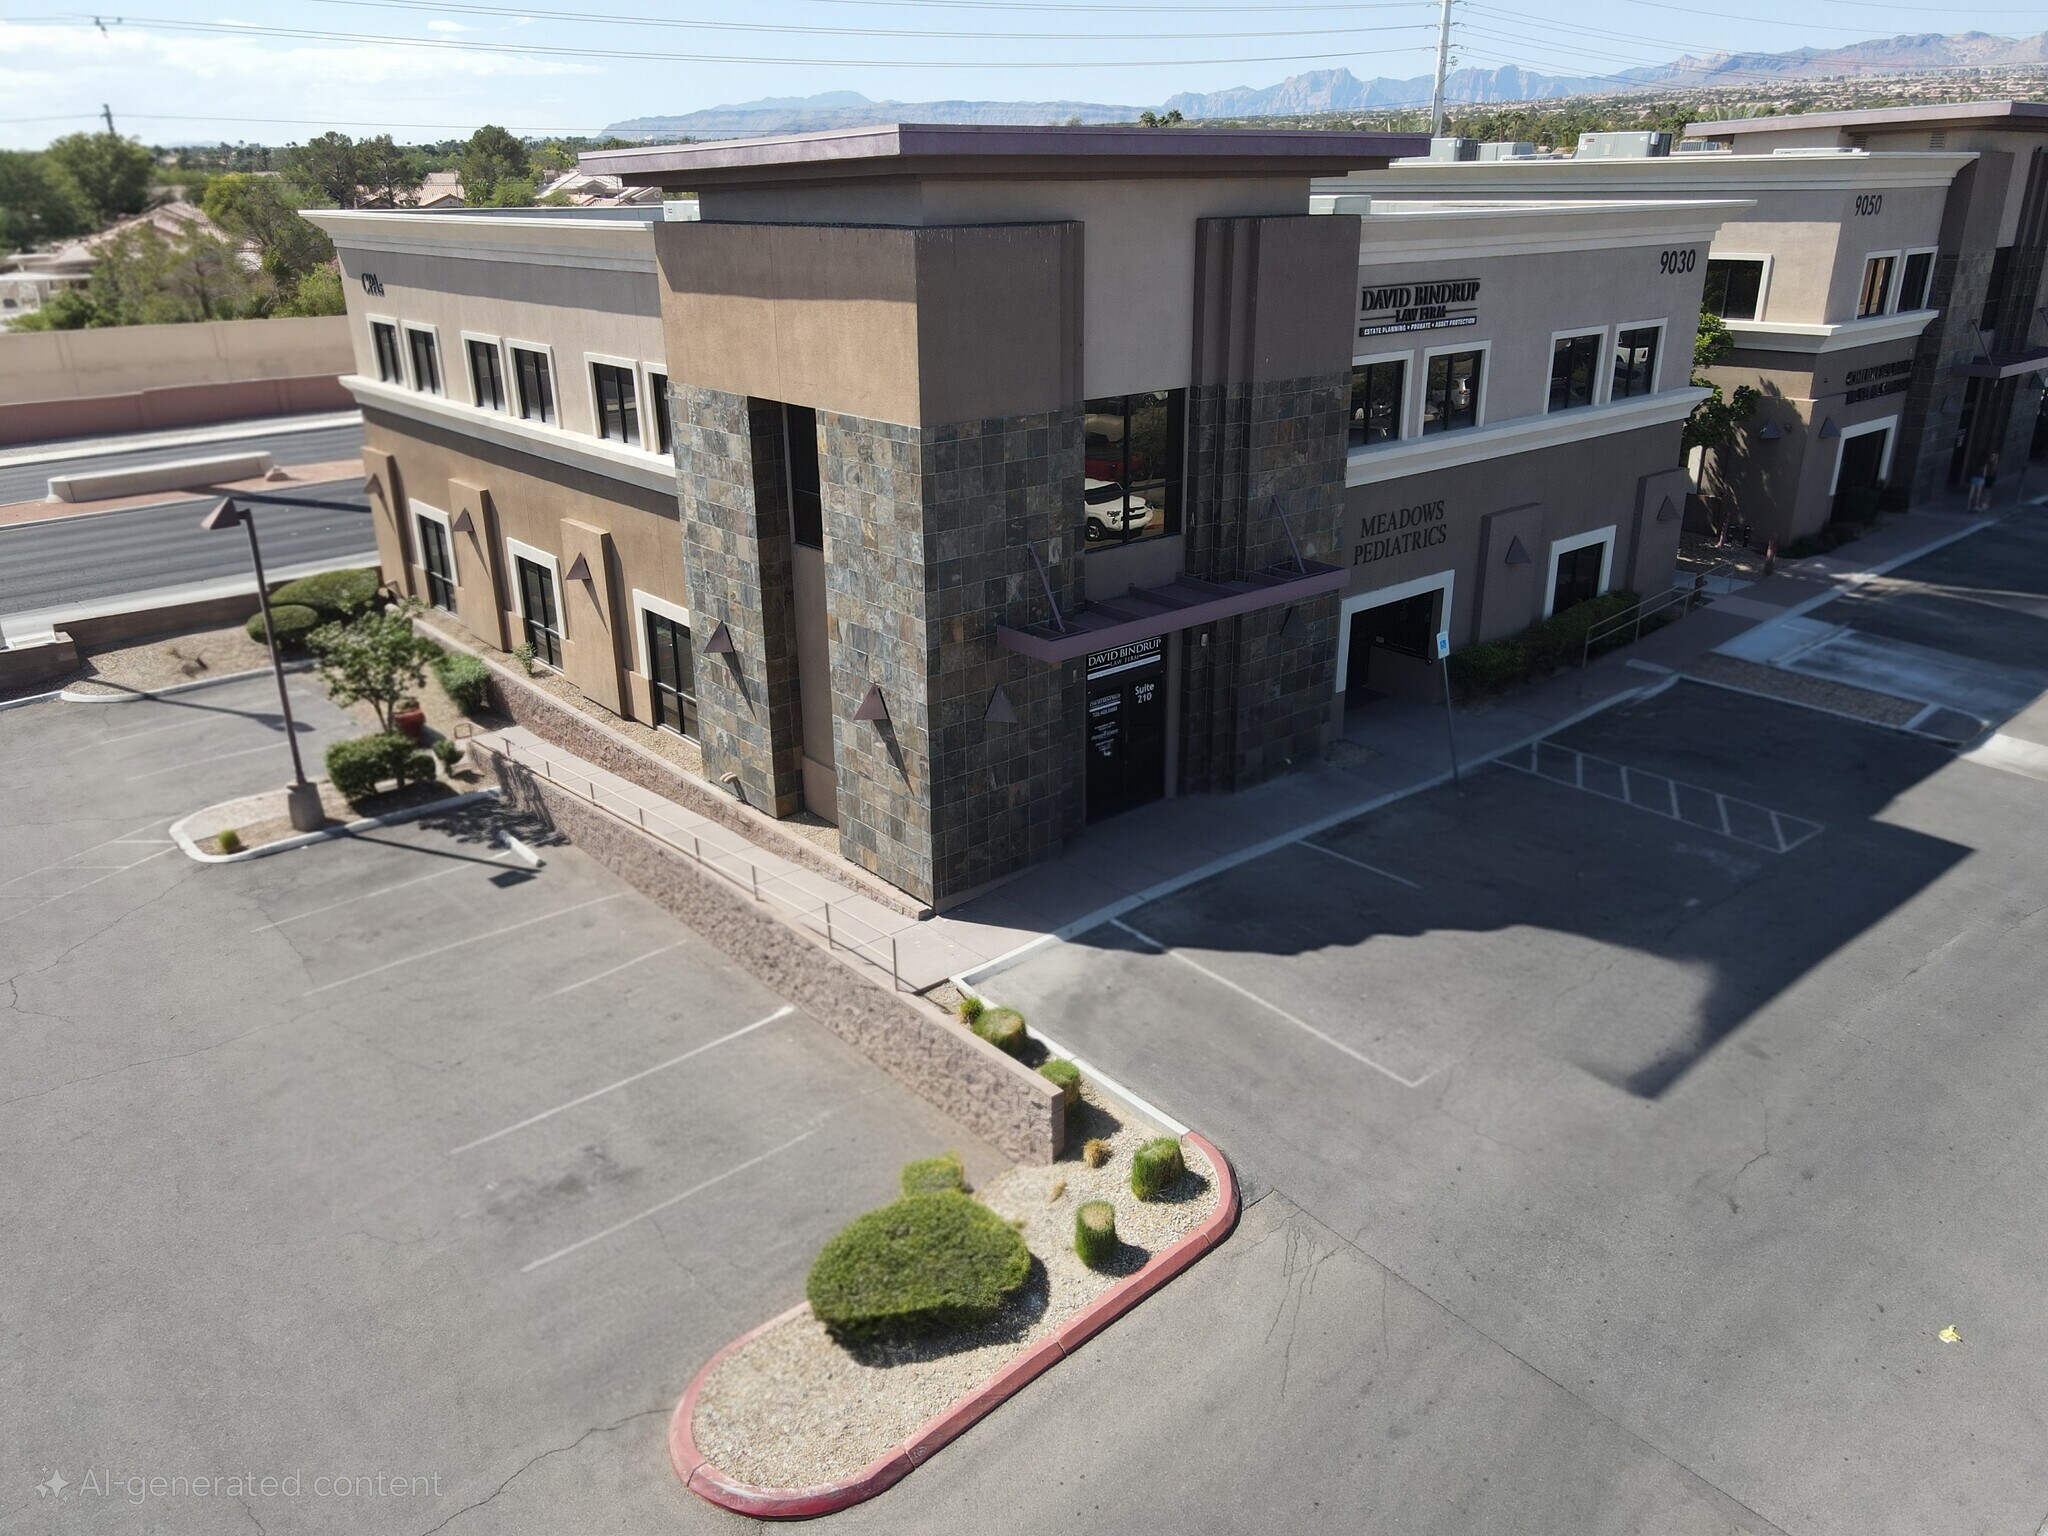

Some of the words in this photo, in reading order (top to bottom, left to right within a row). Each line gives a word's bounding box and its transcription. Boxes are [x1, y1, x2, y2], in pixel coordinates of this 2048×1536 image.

[1855, 194, 1883, 217] 9050
[1660, 249, 1696, 274] 9030
[1361, 287, 1412, 311] DAVID
[1414, 281, 1481, 306] BINDRUP
[1395, 309, 1418, 322] LAW
[1420, 305, 1446, 320] FIRM
[1364, 327, 1382, 335] ESTATE
[1383, 325, 1406, 333] PLANNING
[1411, 322, 1431, 330] PROBATE
[1435, 320, 1449, 328] ASSET
[1449, 317, 1475, 326] PROTECTION
[1360, 500, 1445, 538] MEADOWS
[1353, 524, 1447, 566] PEDIATRICS
[1088, 651, 1118, 666] DAVID
[1120, 639, 1161, 657] BINDRUP
[1110, 659, 1122, 667] LAW
[1124, 654, 1140, 663] FIRM
[1135, 684, 1154, 695] Suite
[1138, 692, 1152, 703] 210
